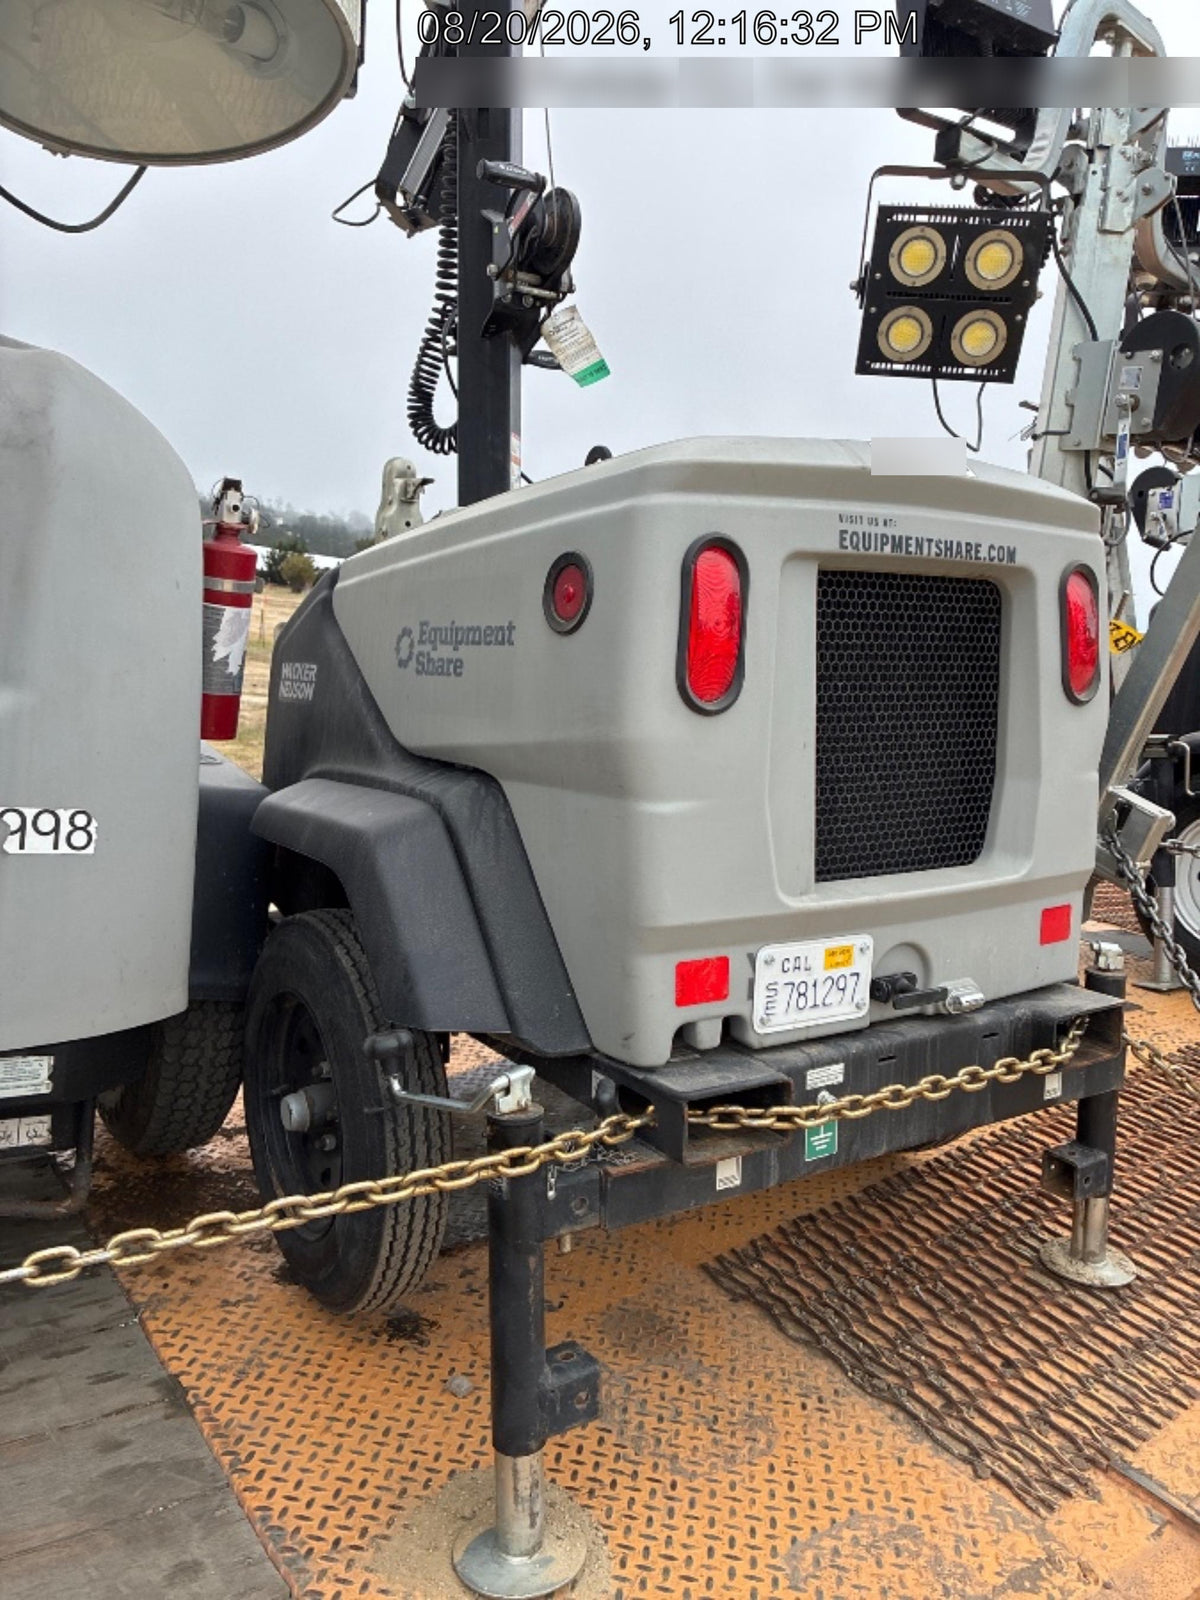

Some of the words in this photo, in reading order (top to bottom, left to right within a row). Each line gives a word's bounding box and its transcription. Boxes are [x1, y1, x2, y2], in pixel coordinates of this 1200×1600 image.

[838, 513, 863, 525] VISIT
[867, 516, 879, 527] US
[838, 529, 1017, 564] EQUIPMENTSHARE.COM
[417, 619, 516, 651] Equipment
[415, 651, 464, 677] Share
[781, 956, 811, 973] CAL
[764, 981, 779, 1016] SE
[783, 972, 861, 1014] 781297
